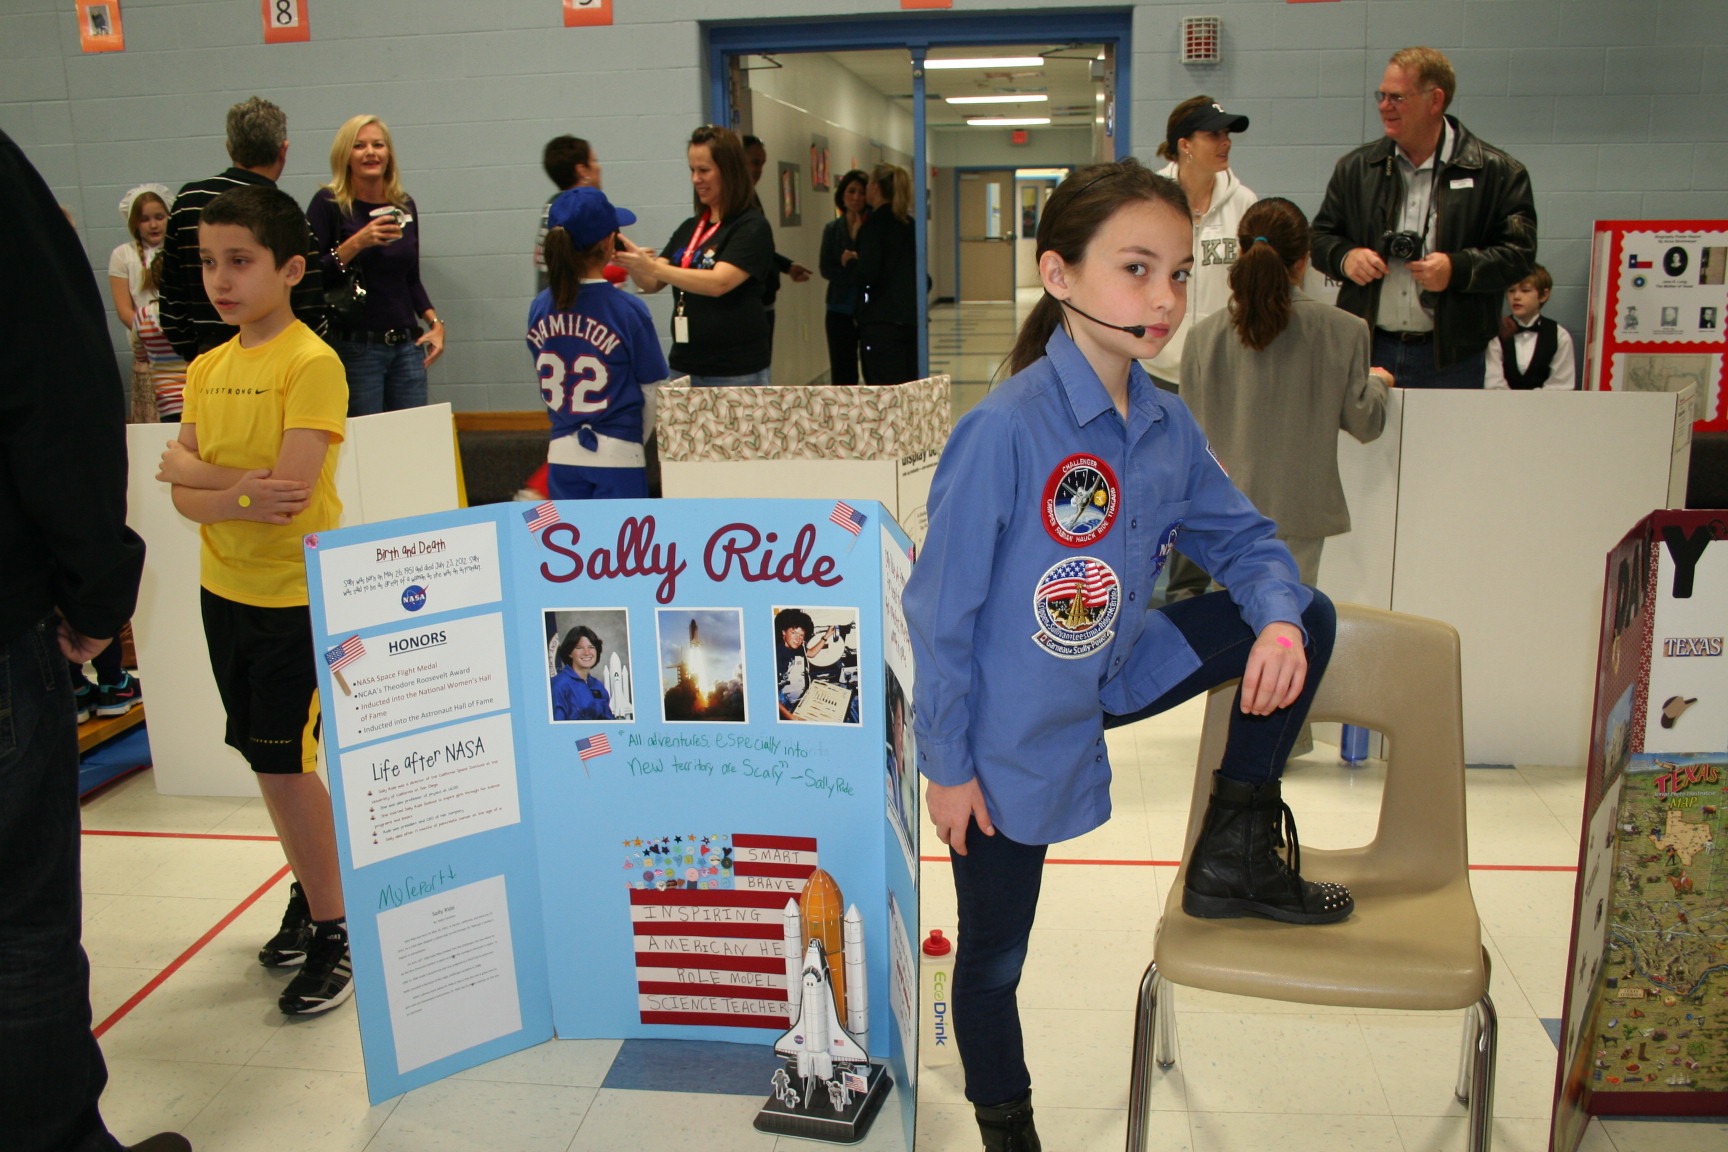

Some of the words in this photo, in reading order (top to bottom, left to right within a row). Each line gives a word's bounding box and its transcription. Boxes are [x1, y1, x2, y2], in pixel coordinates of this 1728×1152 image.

[276, 0, 292, 25] 8
[527, 313, 621, 355] HAMILTON
[536, 352, 609, 413] 32
[1062, 458, 1098, 473] CHALLENGER
[376, 547, 400, 561] Birth
[402, 543, 416, 558] and
[419, 538, 446, 554] Death
[540, 515, 687, 605] Sally
[703, 522, 844, 587] Ride
[403, 594, 426, 604] NASA
[389, 631, 447, 654] HONORS
[1664, 637, 1722, 657] TEXAS
[356, 676, 375, 687] NASA
[376, 672, 396, 682] Space
[397, 668, 415, 677] Flight
[417, 662, 438, 672] Medal
[384, 680, 415, 692] Theodore
[416, 672, 448, 684] Roosevelt
[450, 667, 470, 677] Award
[361, 697, 390, 710] Inducted
[391, 693, 405, 702] into
[406, 690, 418, 699] the
[418, 684, 446, 696] National
[479, 674, 492, 683] Hall
[364, 721, 393, 734] Inducted
[394, 717, 408, 726] into
[408, 714, 420, 722] the
[421, 706, 453, 719] Astronaut
[454, 703, 467, 711] Hall
[468, 700, 475, 708] of
[476, 698, 494, 706] Fame
[369, 711, 388, 720] Fame
[372, 759, 401, 782] Life
[404, 750, 441, 774] after
[446, 737, 485, 763] NASA
[784, 741, 808, 758] into
[672, 755, 714, 777] territory
[836, 778, 855, 796] Ride
[1653, 764, 1720, 800] TEXAS
[1670, 797, 1698, 808] MAP
[748, 849, 800, 864] SMART
[748, 877, 797, 892] BRAVE
[379, 884, 403, 909] My
[645, 906, 762, 922] INSPIRING
[649, 936, 748, 956] AMERICAN
[677, 968, 720, 985] ROLE
[730, 971, 777, 988] MODEL
[647, 996, 718, 1011] SCIENCE
[725, 997, 790, 1014] TEACHER
